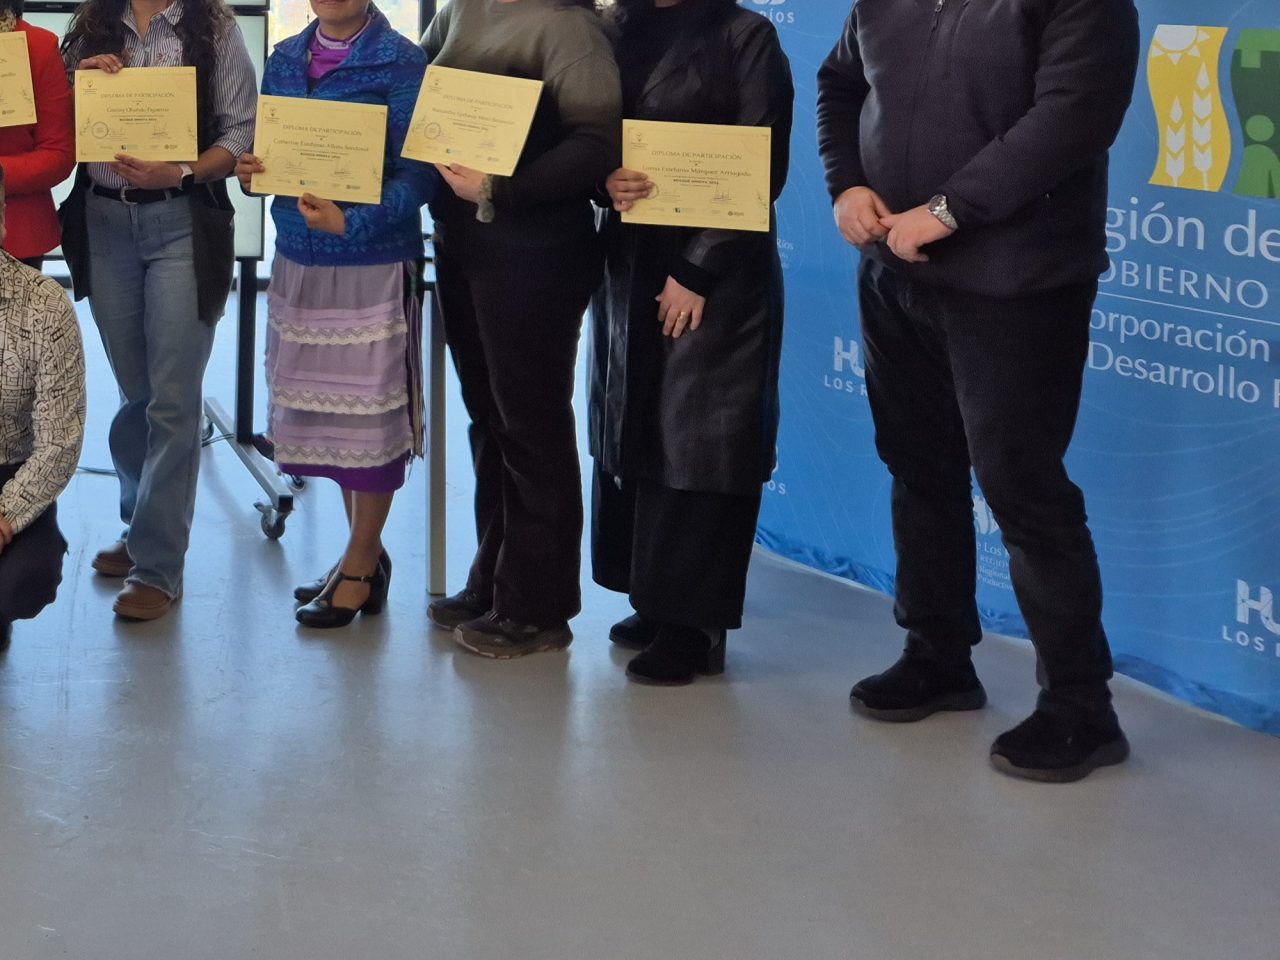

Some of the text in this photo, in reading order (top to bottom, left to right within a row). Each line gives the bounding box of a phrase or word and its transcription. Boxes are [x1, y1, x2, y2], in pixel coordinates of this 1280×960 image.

[1223, 208, 1280, 262] de
[824, 374, 854, 393] LOS
[1087, 341, 1261, 404] Desarrollo
[1222, 624, 1265, 652] LOS
